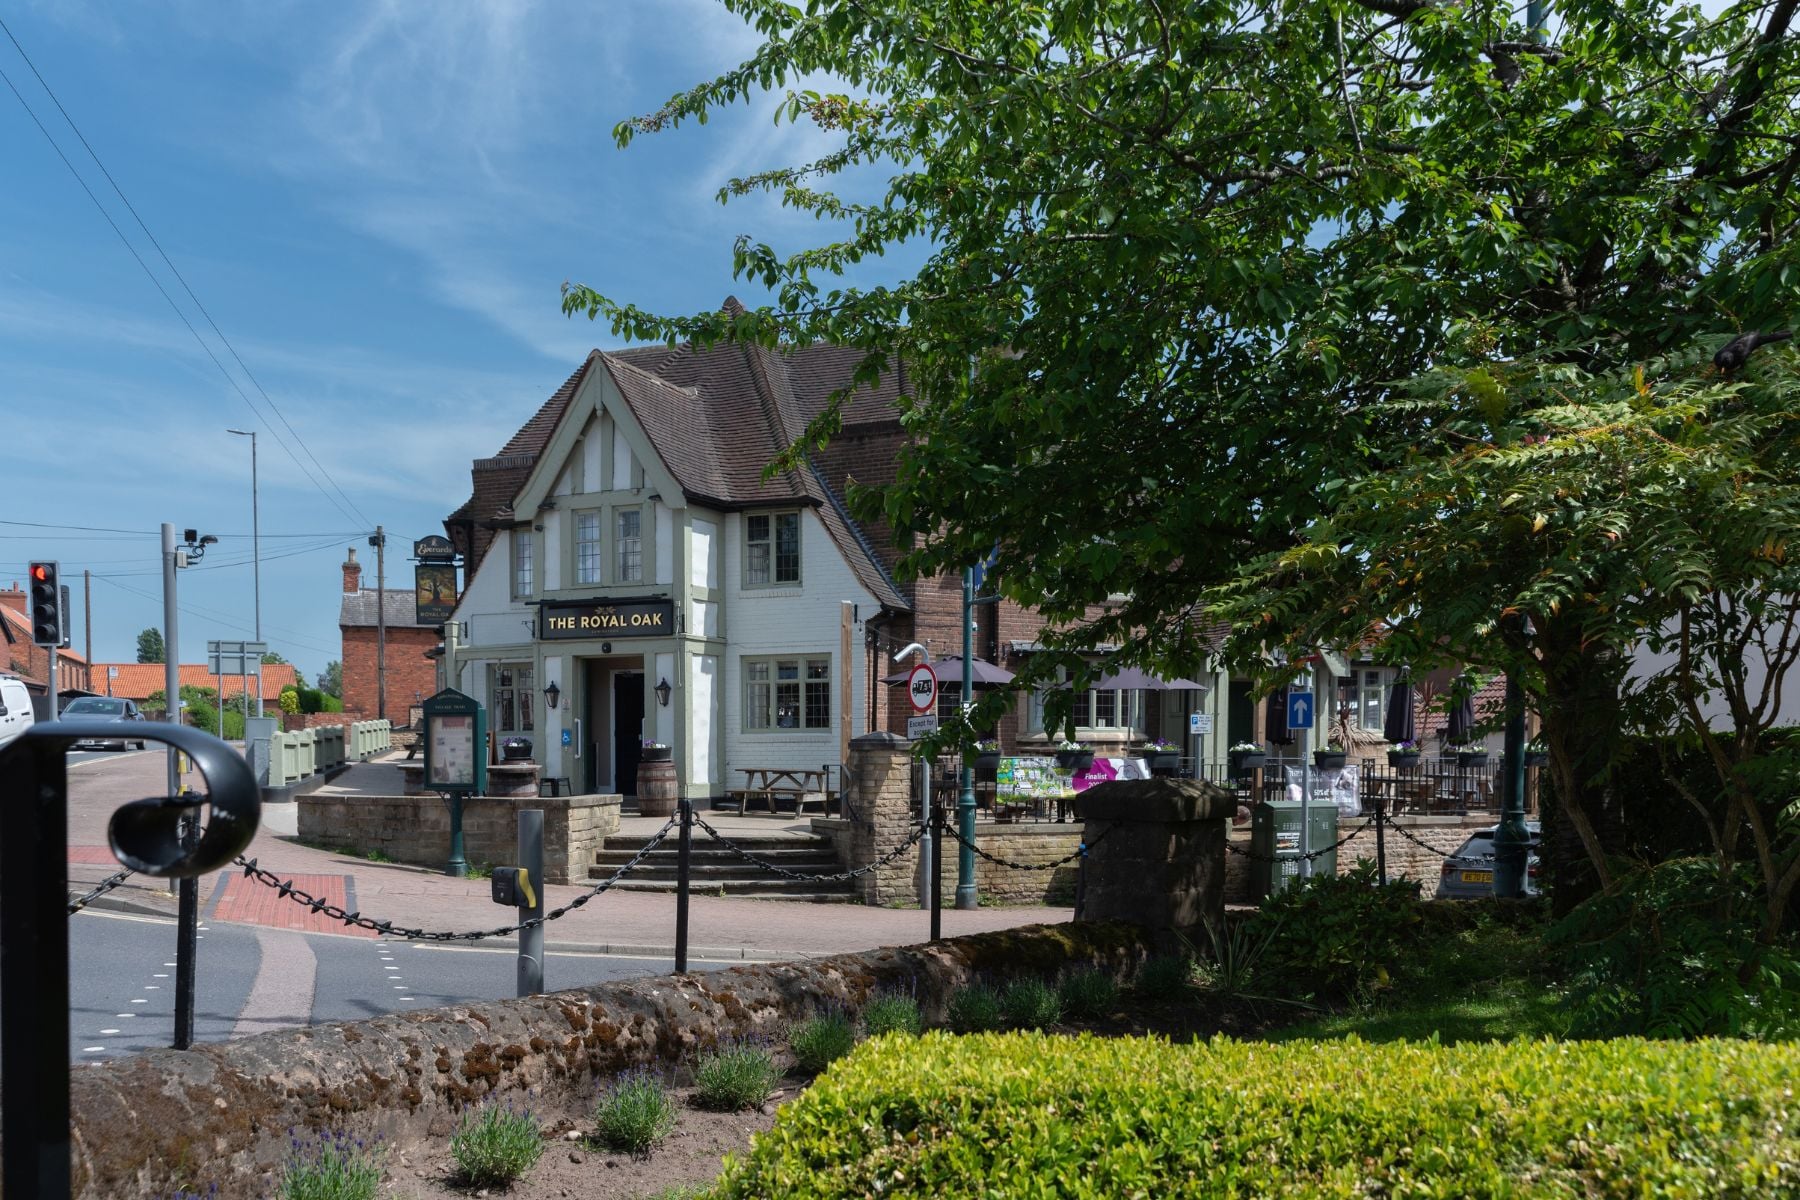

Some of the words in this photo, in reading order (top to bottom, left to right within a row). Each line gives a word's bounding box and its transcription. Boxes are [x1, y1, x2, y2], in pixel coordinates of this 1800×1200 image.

[548, 617, 576, 630] THE
[581, 615, 627, 628] ROYAL
[631, 613, 662, 626] OAK
[909, 720, 926, 728] Except
